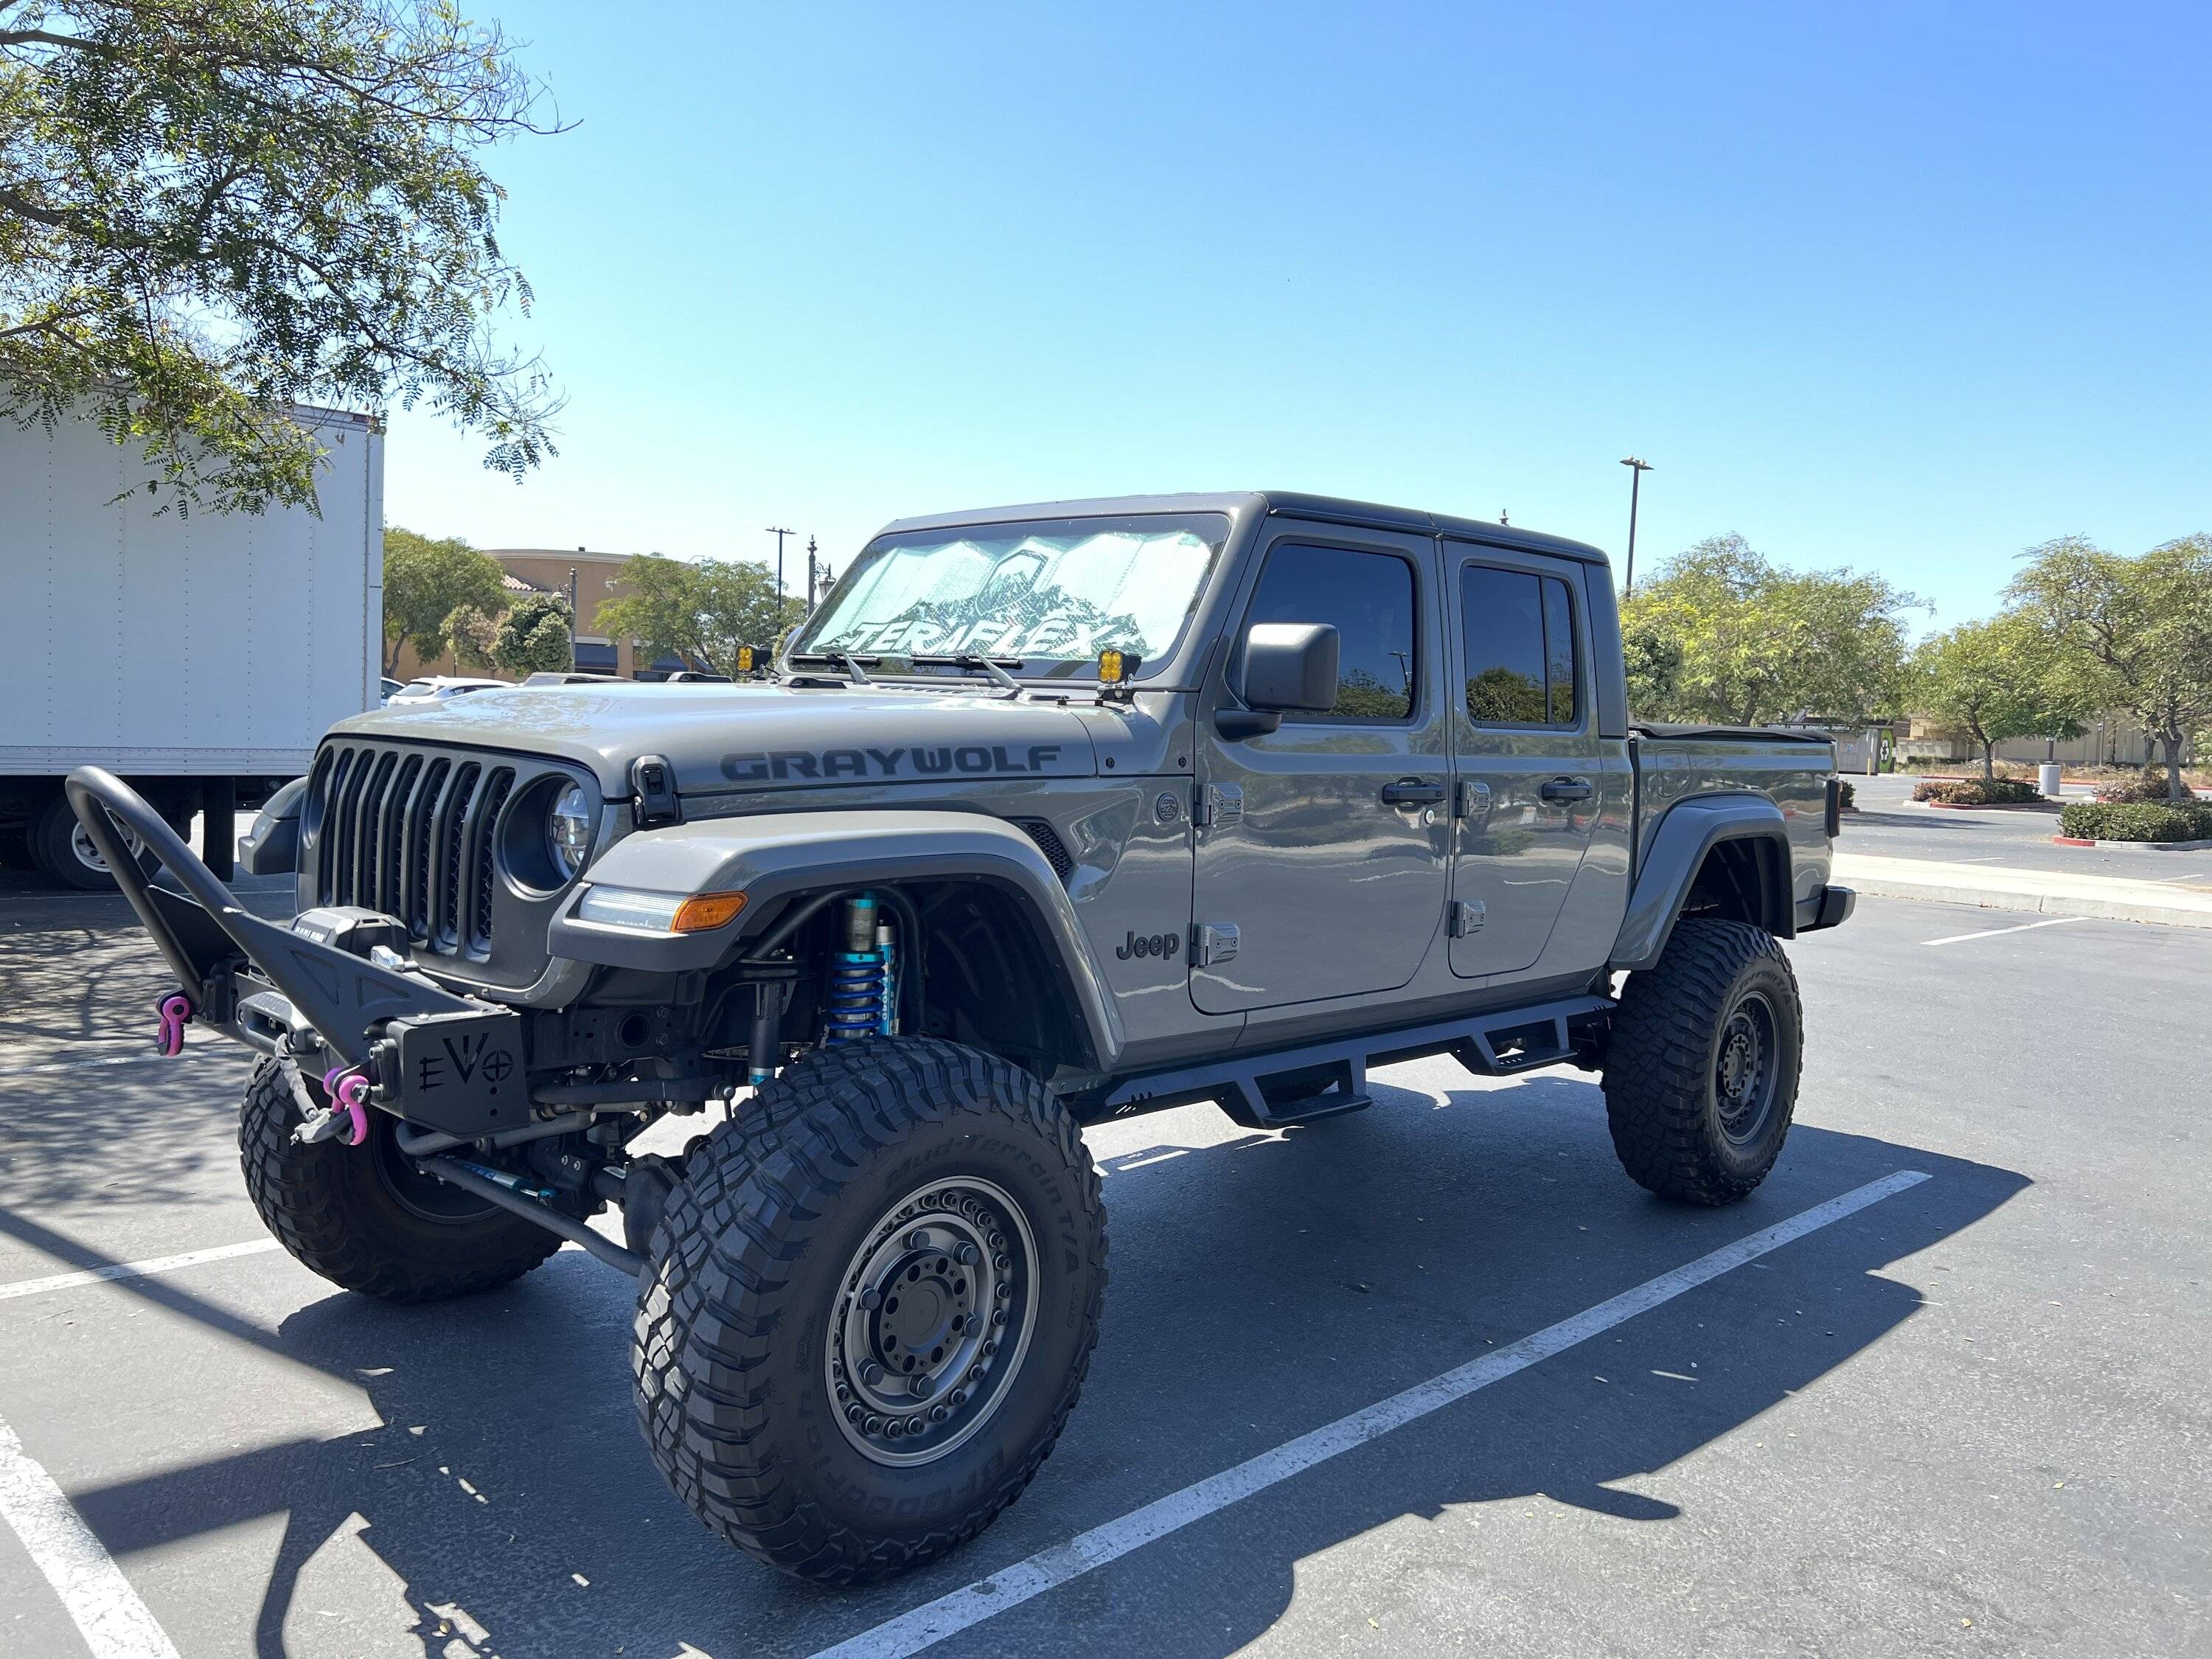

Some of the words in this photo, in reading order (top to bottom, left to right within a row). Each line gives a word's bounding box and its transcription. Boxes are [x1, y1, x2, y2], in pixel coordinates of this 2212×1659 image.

[847, 619, 1119, 656] TERAFLEX
[719, 745, 1062, 782] GRAYWOLF
[1116, 931, 1180, 960] Jeep
